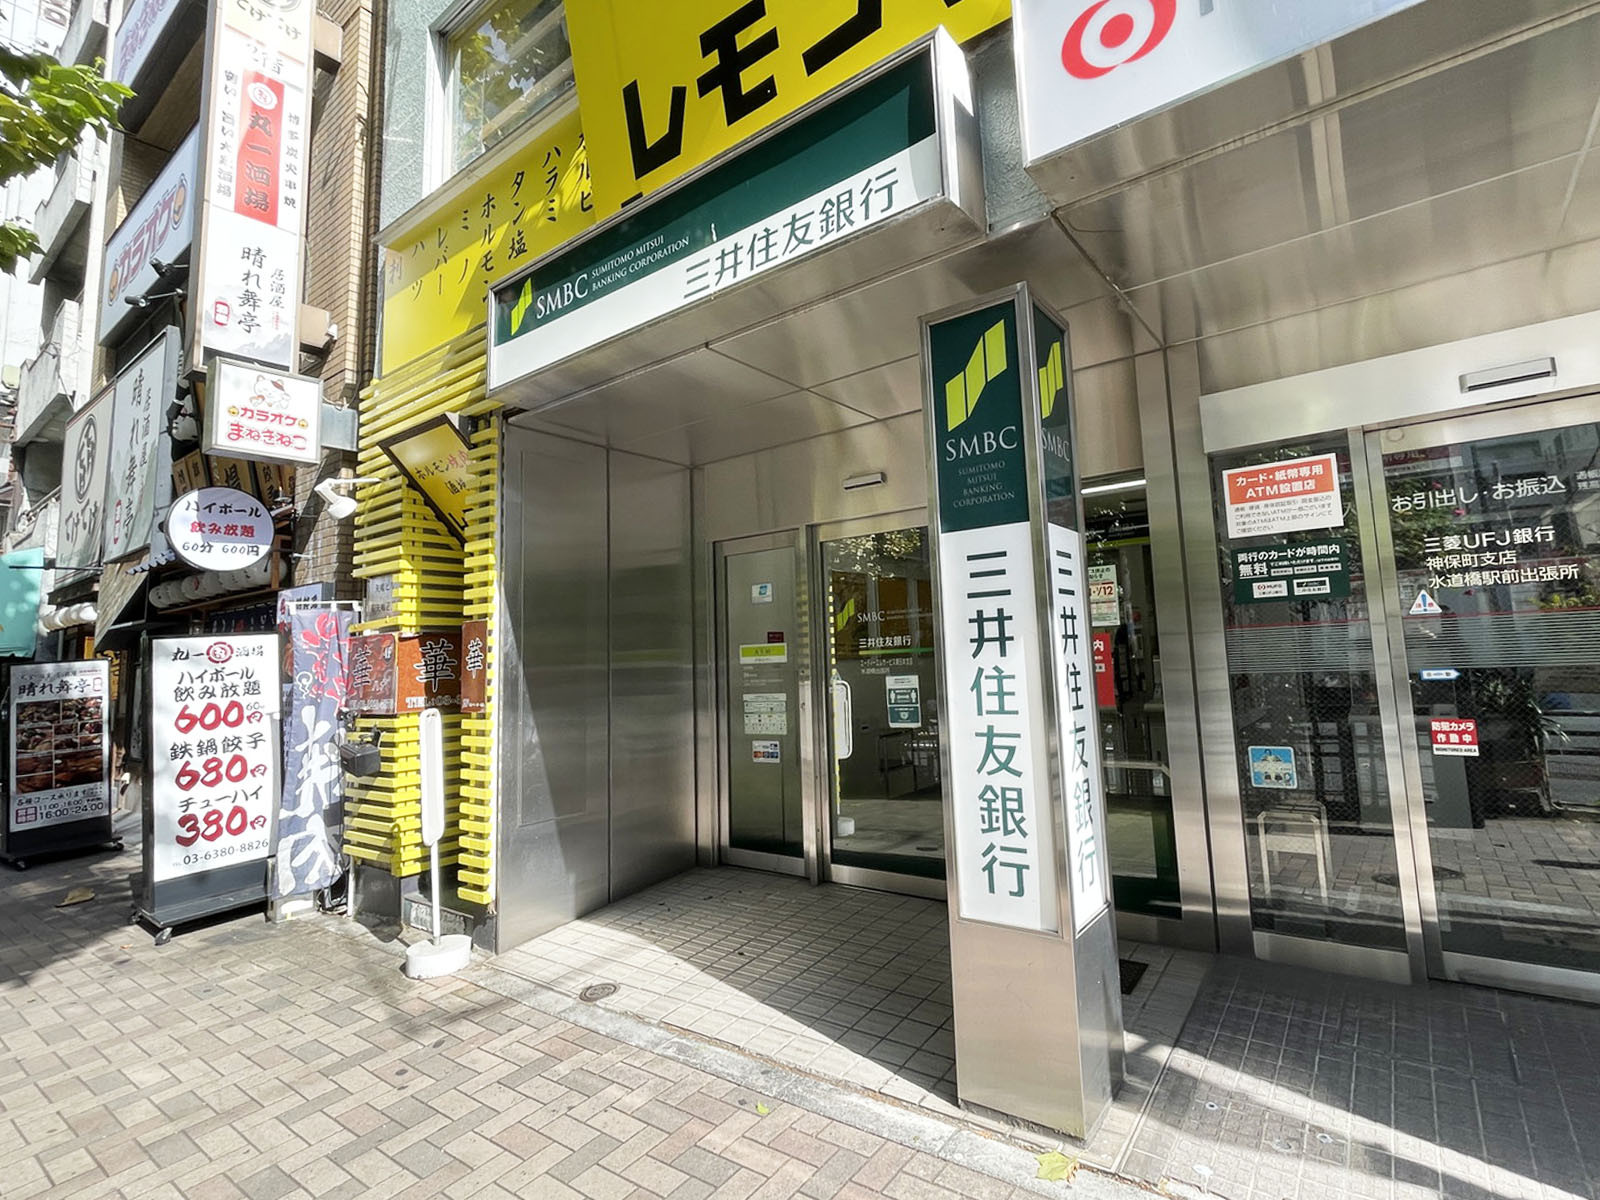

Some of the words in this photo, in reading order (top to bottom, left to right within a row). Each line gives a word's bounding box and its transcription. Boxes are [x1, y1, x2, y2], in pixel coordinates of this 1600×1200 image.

[542, 146, 561, 222] ハラミ
[507, 169, 528, 261] タン塩
[683, 167, 899, 299] 三井住友銀行
[433, 227, 449, 295] レバー
[591, 250, 634, 278] SUMITOMO
[635, 234, 665, 257] MITSUI
[592, 269, 629, 292] BANKING
[628, 235, 690, 274] CORPORATION
[237, 247, 267, 334] 晴れ舞亭
[269, 268, 286, 309] 居酒屋
[536, 273, 589, 320] SMBC
[240, 407, 298, 426] カラオケ
[227, 420, 308, 450] まねきねこ
[945, 425, 1018, 463] SMBC
[1041, 427, 1071, 462] SMBC
[958, 460, 1006, 476] SUMITOMO
[967, 472, 997, 485] MITSUI
[1236, 464, 1324, 487] カード・紙幣専用
[952, 491, 1016, 508] CORPORATION
[963, 482, 1003, 496] BANKING
[1245, 479, 1316, 499] ATM設置店
[1391, 475, 1567, 513] お引出し・お振込
[185, 500, 262, 518] ハイボール
[190, 520, 255, 538] 飲み放題
[1423, 525, 1556, 553] 三菱UFJ銀行
[182, 541, 214, 553] 60分
[222, 544, 260, 556] 600円
[1237, 544, 1340, 563] 両行のカードが時間内
[1426, 549, 1517, 571] 神保町支店
[1239, 562, 1268, 577] 無料
[1429, 564, 1580, 589] 水道橋駅前出張所
[857, 610, 886, 623] SMBC
[171, 647, 205, 662] 丸一
[235, 645, 264, 657] 酒場
[858, 635, 912, 649] 三井住友銀行
[177, 666, 255, 685] ハイボール
[412, 638, 459, 694] 華
[17, 677, 92, 698] 晴れ舞亭
[173, 679, 262, 703] 飲み放題
[965, 549, 1030, 899] 三井住友銀行
[1055, 548, 1098, 895] 三井住友銀行
[1431, 721, 1474, 732] 防犯カメラ
[169, 732, 267, 761] 鉄鍋餃子
[1436, 733, 1473, 744] 作動中
[178, 785, 263, 813] チューハイ
[183, 838, 269, 866] 03-6380-8826
